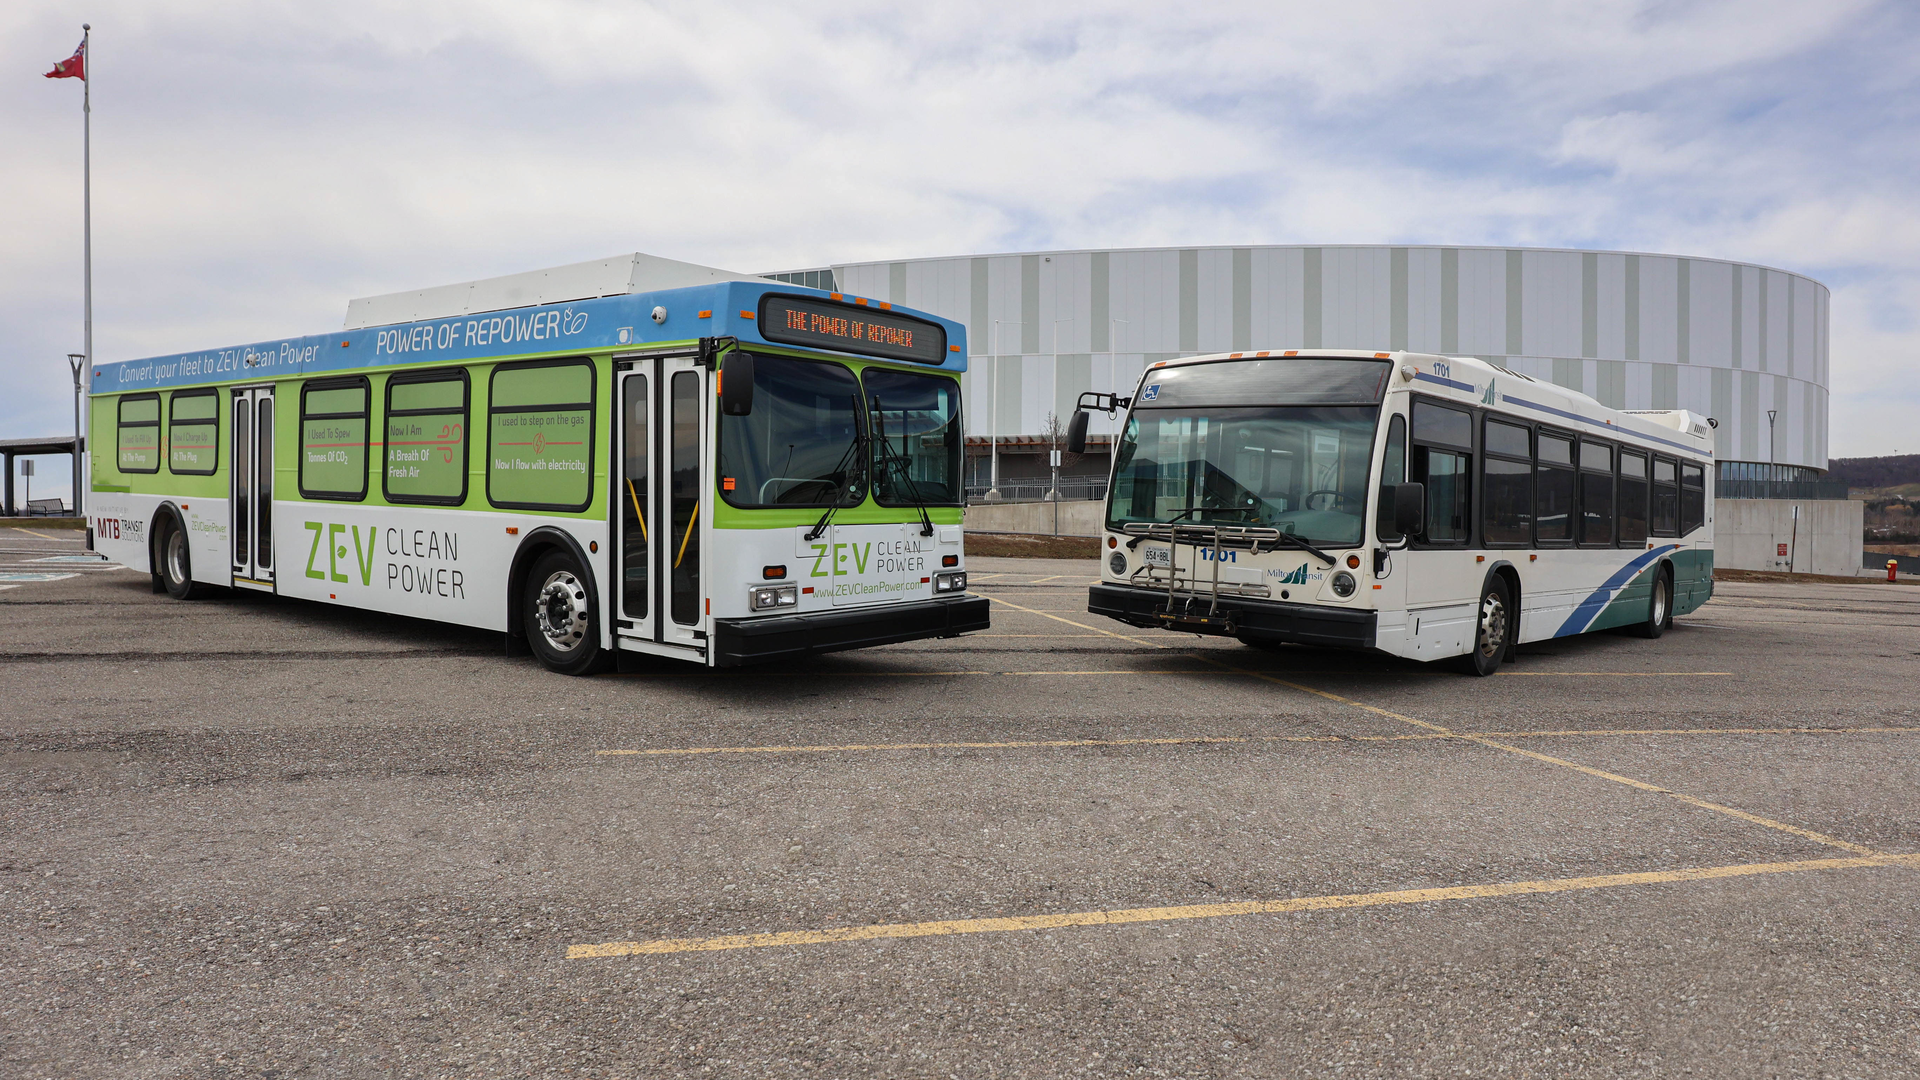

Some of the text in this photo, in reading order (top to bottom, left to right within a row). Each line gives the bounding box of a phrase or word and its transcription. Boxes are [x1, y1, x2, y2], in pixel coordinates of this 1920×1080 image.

[376, 310, 561, 355] POWER OF REPOWER
[785, 309, 913, 348] THE POWER OF REPOWER
[119, 361, 153, 383] Convert
[155, 364, 177, 384] your
[179, 356, 201, 376] fleet
[203, 358, 214, 373] to
[217, 349, 241, 372] ZEV
[279, 342, 319, 365] Power
[1433, 361, 1450, 378] 1701
[498, 416, 501, 426] I
[502, 415, 519, 426] used
[520, 416, 527, 426] to
[529, 415, 544, 428] step
[556, 414, 569, 425] the
[570, 416, 585, 427] gas
[173, 432, 182, 441] Now
[186, 432, 201, 443] Charge
[201, 432, 208, 443] Up
[311, 428, 326, 439] Used
[327, 428, 334, 438] To
[334, 427, 350, 441] Spew
[390, 424, 422, 436] Now I Am
[146, 434, 152, 444] Up
[122, 453, 127, 462] At
[134, 453, 146, 464] Pump
[173, 451, 197, 464] At The Plug
[307, 451, 326, 462] Tonnes
[327, 451, 335, 462] Of
[389, 449, 430, 461] A Breath Of
[389, 466, 420, 478] Fresh Air
[495, 458, 586, 473] Now I flow with electricity
[97, 517, 120, 539] MTB
[121, 519, 143, 532] TRANSIT
[191, 520, 227, 533] ZEVCleanPower
[121, 531, 144, 542] SOLUTIONS
[386, 527, 458, 561] CLEAN
[304, 521, 377, 587] ZEV
[877, 540, 921, 556] CLEAN
[1200, 547, 1237, 563] 1701
[810, 542, 871, 577] ZEV
[877, 557, 924, 573] POWER
[387, 563, 465, 600] POWER
[812, 580, 922, 598] www.ZEVCleanPower.com
